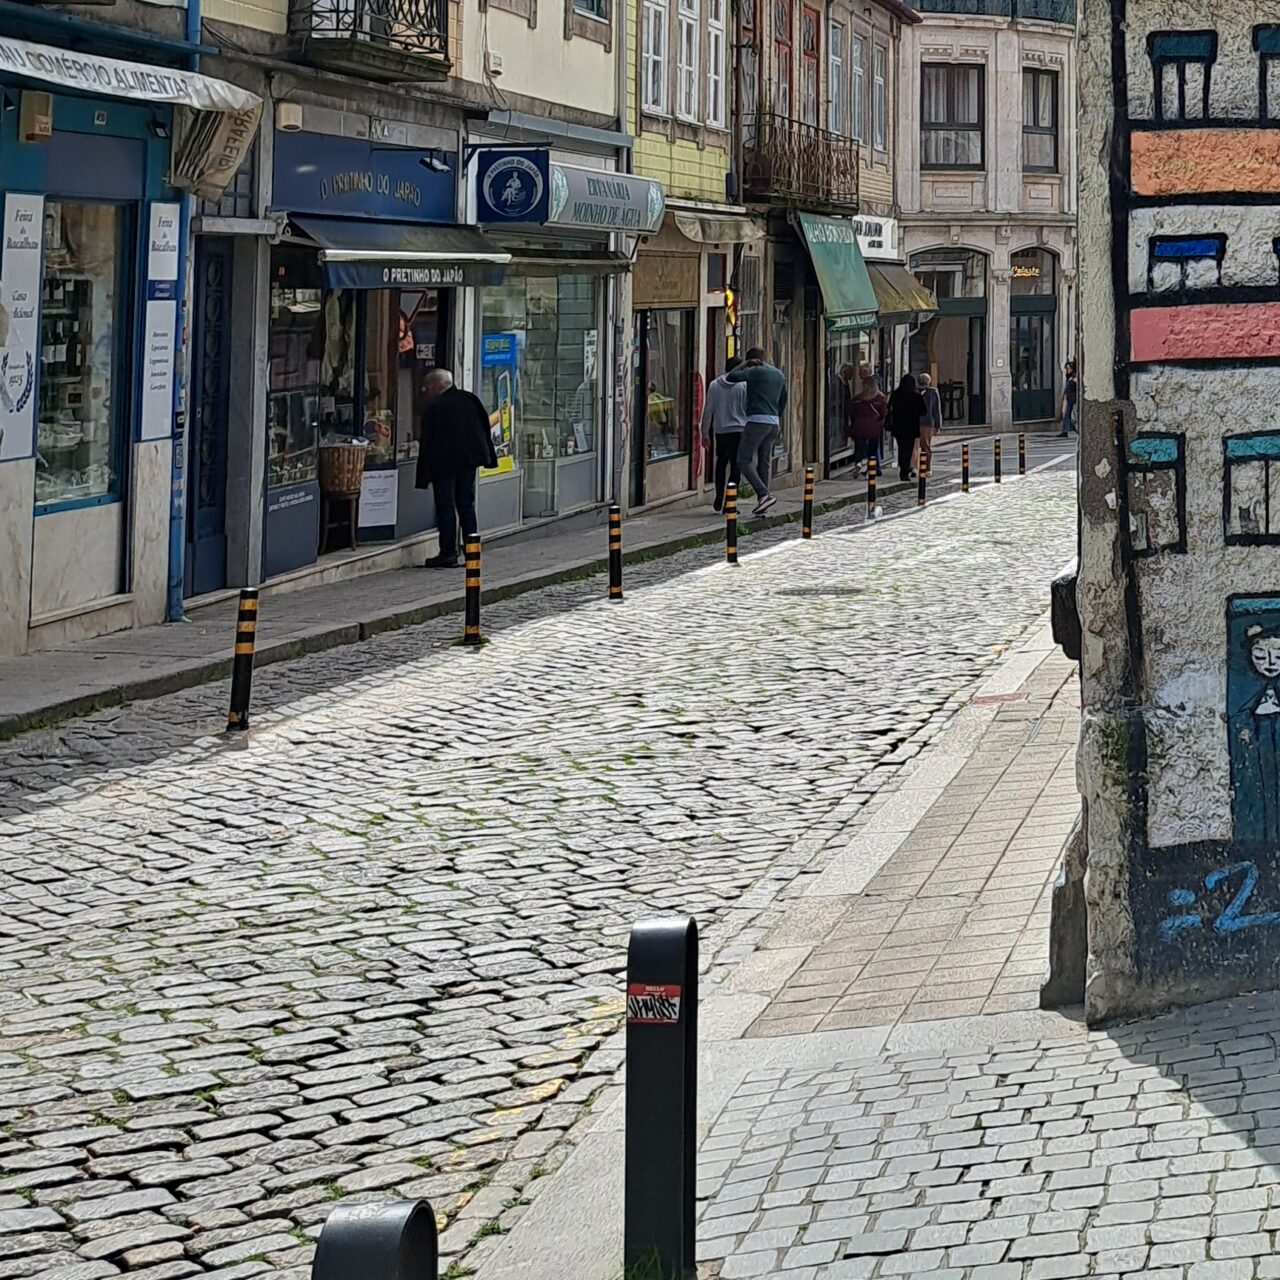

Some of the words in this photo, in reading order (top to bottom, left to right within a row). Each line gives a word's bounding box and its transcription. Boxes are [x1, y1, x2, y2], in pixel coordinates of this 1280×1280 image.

[25, 51, 112, 86] COMÉRCIO
[331, 170, 373, 195] PRETINHO
[377, 173, 391, 196] DO
[586, 177, 631, 201] ERVANÁRIA
[571, 201, 607, 225] MOINHO
[606, 205, 620, 226] DE
[620, 202, 641, 228] ÁGUA
[383, 267, 390, 283] O
[391, 267, 430, 283] PRETINHO
[430, 268, 441, 283] DO
[442, 265, 464, 283] JAPÃO
